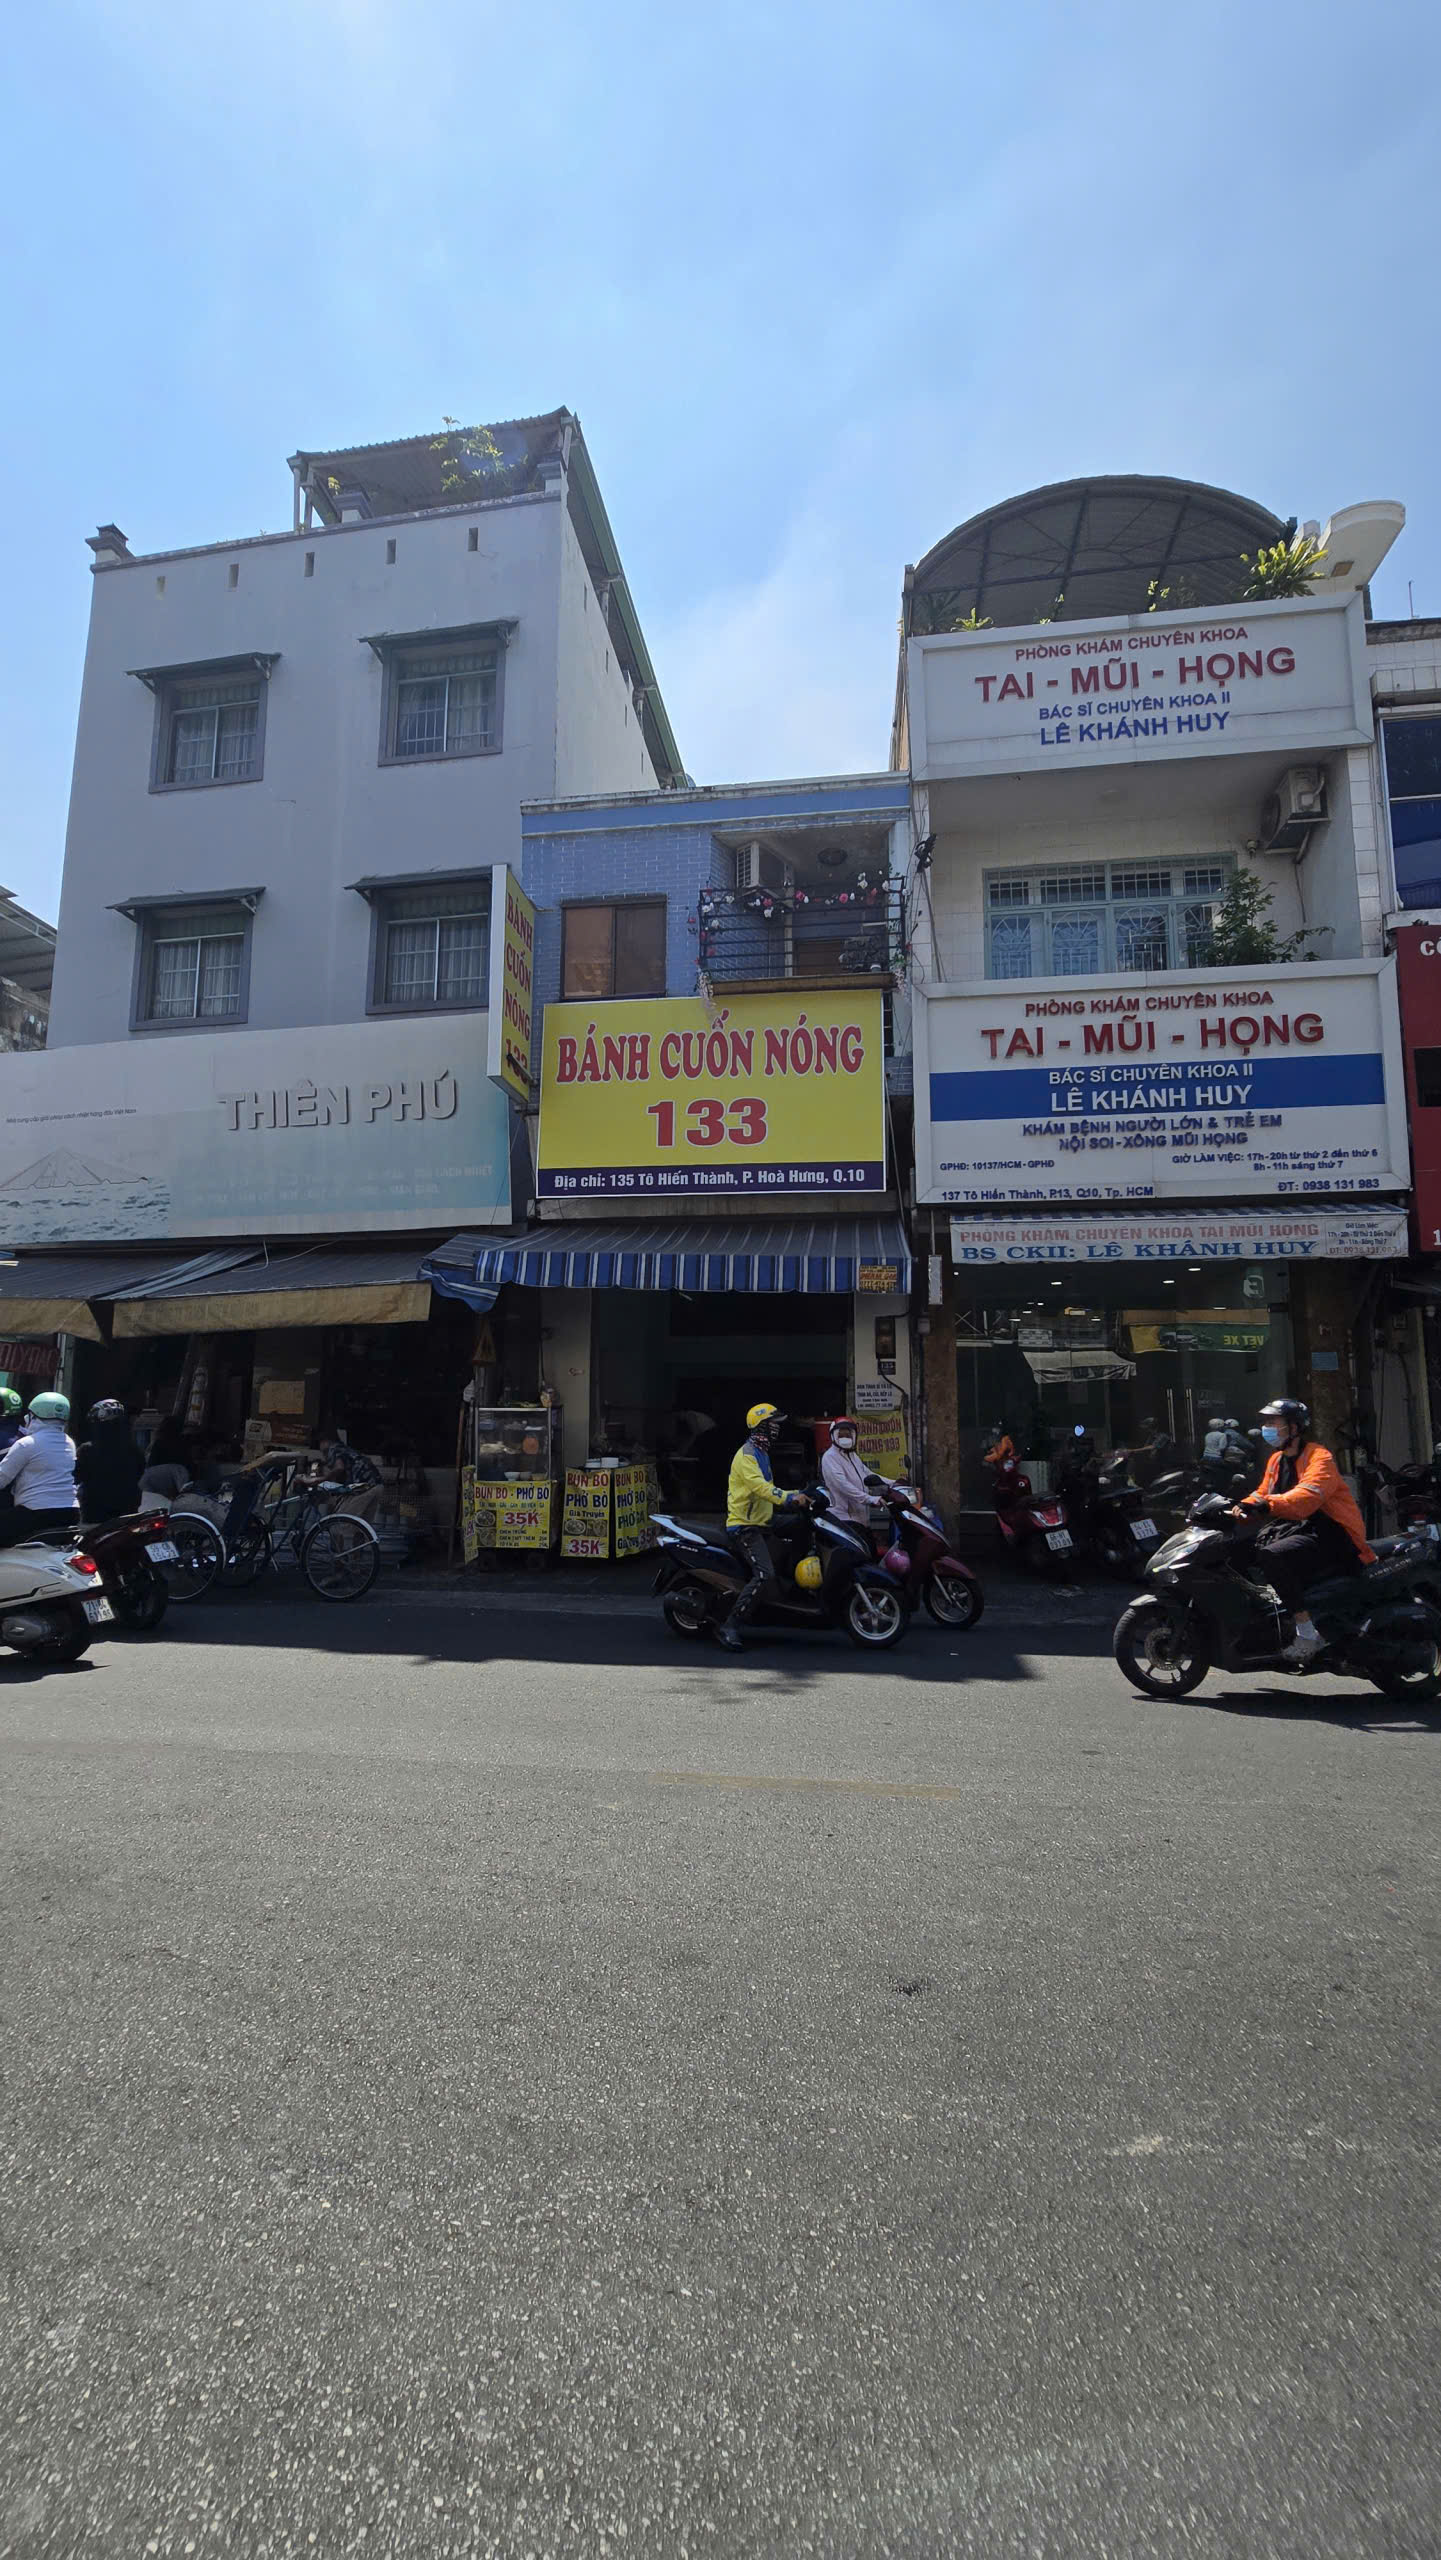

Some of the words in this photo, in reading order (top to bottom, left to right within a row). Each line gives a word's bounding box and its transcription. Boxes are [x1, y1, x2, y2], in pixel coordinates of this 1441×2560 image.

[1015, 644, 1072, 661] PHÒNG
[1077, 638, 1123, 656] KHÁM
[1128, 631, 1196, 649] CHUYÊN
[1200, 627, 1249, 642] KHOA
[975, 671, 1035, 702] TAI
[1071, 656, 1140, 695] MŨI
[1178, 647, 1296, 687] HỌNG
[1039, 704, 1073, 721] BÁC
[1077, 699, 1094, 717] SĨ
[1096, 695, 1167, 715] CHUYÊN
[1169, 692, 1217, 708] KHOA
[1221, 691, 1231, 704] II
[1040, 721, 1072, 745] LÊ
[1079, 716, 1169, 743] KHÁNH
[1176, 711, 1231, 733] HUY
[507, 891, 534, 953] BÁNH
[505, 942, 532, 994] CUỐN
[504, 988, 531, 1042] NÓNG
[1025, 999, 1086, 1017] PHÒNG
[1090, 996, 1140, 1014] KHÁM
[1145, 992, 1217, 1010] CHUYÊN
[1223, 991, 1274, 1007] KHOA
[555, 1023, 651, 1084] BÁNH
[658, 1008, 756, 1081] CUỐN
[764, 1013, 866, 1078] NÓNG
[981, 1026, 1044, 1059] TAI
[1083, 1014, 1156, 1055] MŨI
[1199, 1013, 1324, 1056] HỌNG
[505, 1038, 529, 1085] 133
[1049, 1067, 1085, 1085] BÁC
[1089, 1065, 1107, 1083] SĨ
[1110, 1062, 1184, 1081] CHUYÊN
[1188, 1063, 1240, 1079] KHOA
[1243, 1063, 1253, 1076] II
[216, 1078, 352, 1132] THIÊN
[364, 1069, 459, 1124] PHÚ
[1051, 1087, 1084, 1112] LÊ
[1091, 1085, 1188, 1110] KHÁNH
[1195, 1084, 1253, 1107] HUY
[646, 1096, 769, 1148] 133
[1023, 1121, 1065, 1136] KHÁM
[1070, 1118, 1111, 1137] BỆNH
[1115, 1116, 1167, 1133] NGƯỜI
[1170, 1115, 1203, 1131] LỚN
[1207, 1116, 1219, 1129] &
[1223, 1110, 1255, 1129] TRẺ
[1259, 1114, 1283, 1127] EM
[1059, 1135, 1086, 1154] NỘI
[1171, 1131, 1199, 1147] MŨI
[1202, 1131, 1249, 1149] HỌNG
[1172, 1152, 1191, 1164] GIỜ
[1193, 1151, 1215, 1163] LÀM
[1218, 1151, 1244, 1163] VIỆC:
[1289, 1150, 1301, 1161] từ
[1302, 1149, 1322, 1159] thứ
[1322, 1150, 1328, 1159] 2
[1351, 1148, 1370, 1158] thứ
[1371, 1149, 1378, 1157] 6
[554, 1174, 577, 1191] Địa
[580, 1172, 606, 1188] chỉ:
[609, 1172, 635, 1187] 135
[638, 1172, 655, 1186] Tô
[658, 1170, 690, 1186] Hiến
[692, 1170, 739, 1186] Thành,
[742, 1171, 754, 1184] P.
[758, 1168, 786, 1184] Hoà
[789, 1168, 829, 1185] Hưng,
[833, 1168, 866, 1183] Q.10
[1253, 1162, 1266, 1171] 8h
[1273, 1161, 1289, 1171] 11h
[1291, 1160, 1315, 1172] sáng
[1317, 1160, 1336, 1169] thứ
[1337, 1160, 1343, 1169] 7
[941, 1190, 961, 1201] 137
[962, 1188, 978, 1200] Tô
[1008, 1187, 1047, 1200] Thành,
[1104, 1187, 1123, 1200] Tp.
[1126, 1186, 1154, 1197] HCM
[1277, 1181, 1300, 1192] ĐT:
[1302, 1179, 1331, 1190] 0938
[1334, 1179, 1355, 1189] 131
[1358, 1178, 1380, 1189] 983
[959, 1228, 1016, 1243] PHÒNG
[1021, 1227, 1070, 1241] KHÁM
[1075, 1225, 1143, 1240] CHUYÊN
[1147, 1226, 1194, 1239] KHOA
[1199, 1225, 1224, 1238] TAI
[1229, 1222, 1263, 1238] MŨI
[962, 1246, 998, 1261] BS
[1006, 1244, 1076, 1260] CKII:
[1087, 1241, 1123, 1258] LÊ
[1134, 1240, 1243, 1257] KHÁNH
[1253, 1240, 1320, 1255] HUY
[565, 1489, 589, 1508] PHỞ
[592, 1490, 609, 1508] BÒ
[503, 1511, 539, 1525] 35K
[569, 1538, 600, 1555] 35K
